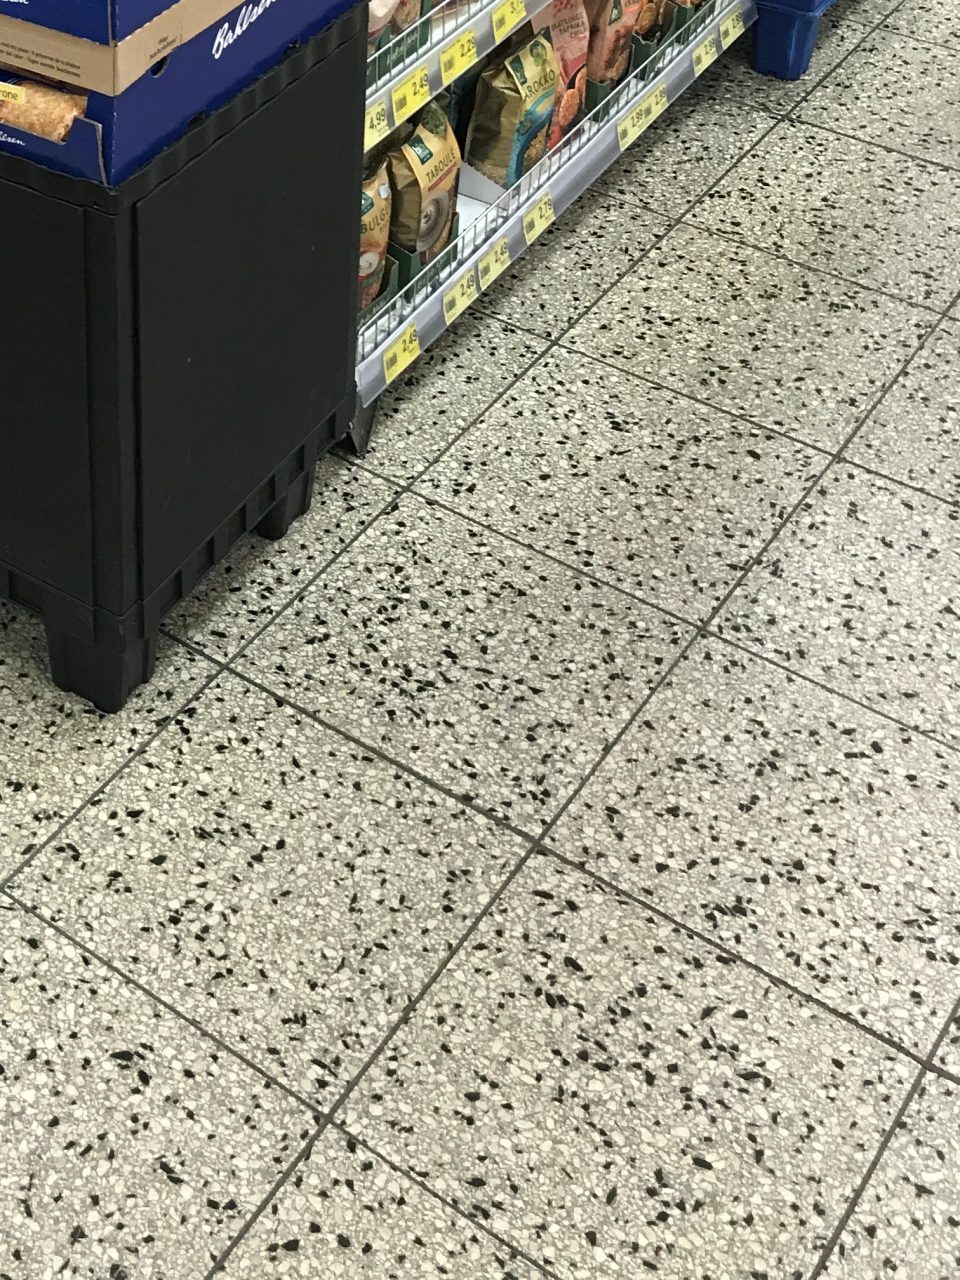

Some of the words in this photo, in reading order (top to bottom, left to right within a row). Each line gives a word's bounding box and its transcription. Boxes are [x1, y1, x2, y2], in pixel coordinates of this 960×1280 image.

[411, 73, 429, 96] 2,49
[369, 107, 386, 129] 4,99
[537, 198, 554, 221] 2,79
[493, 241, 509, 264] 2,49
[460, 275, 476, 298] 2,49
[401, 330, 419, 352] 2,49
